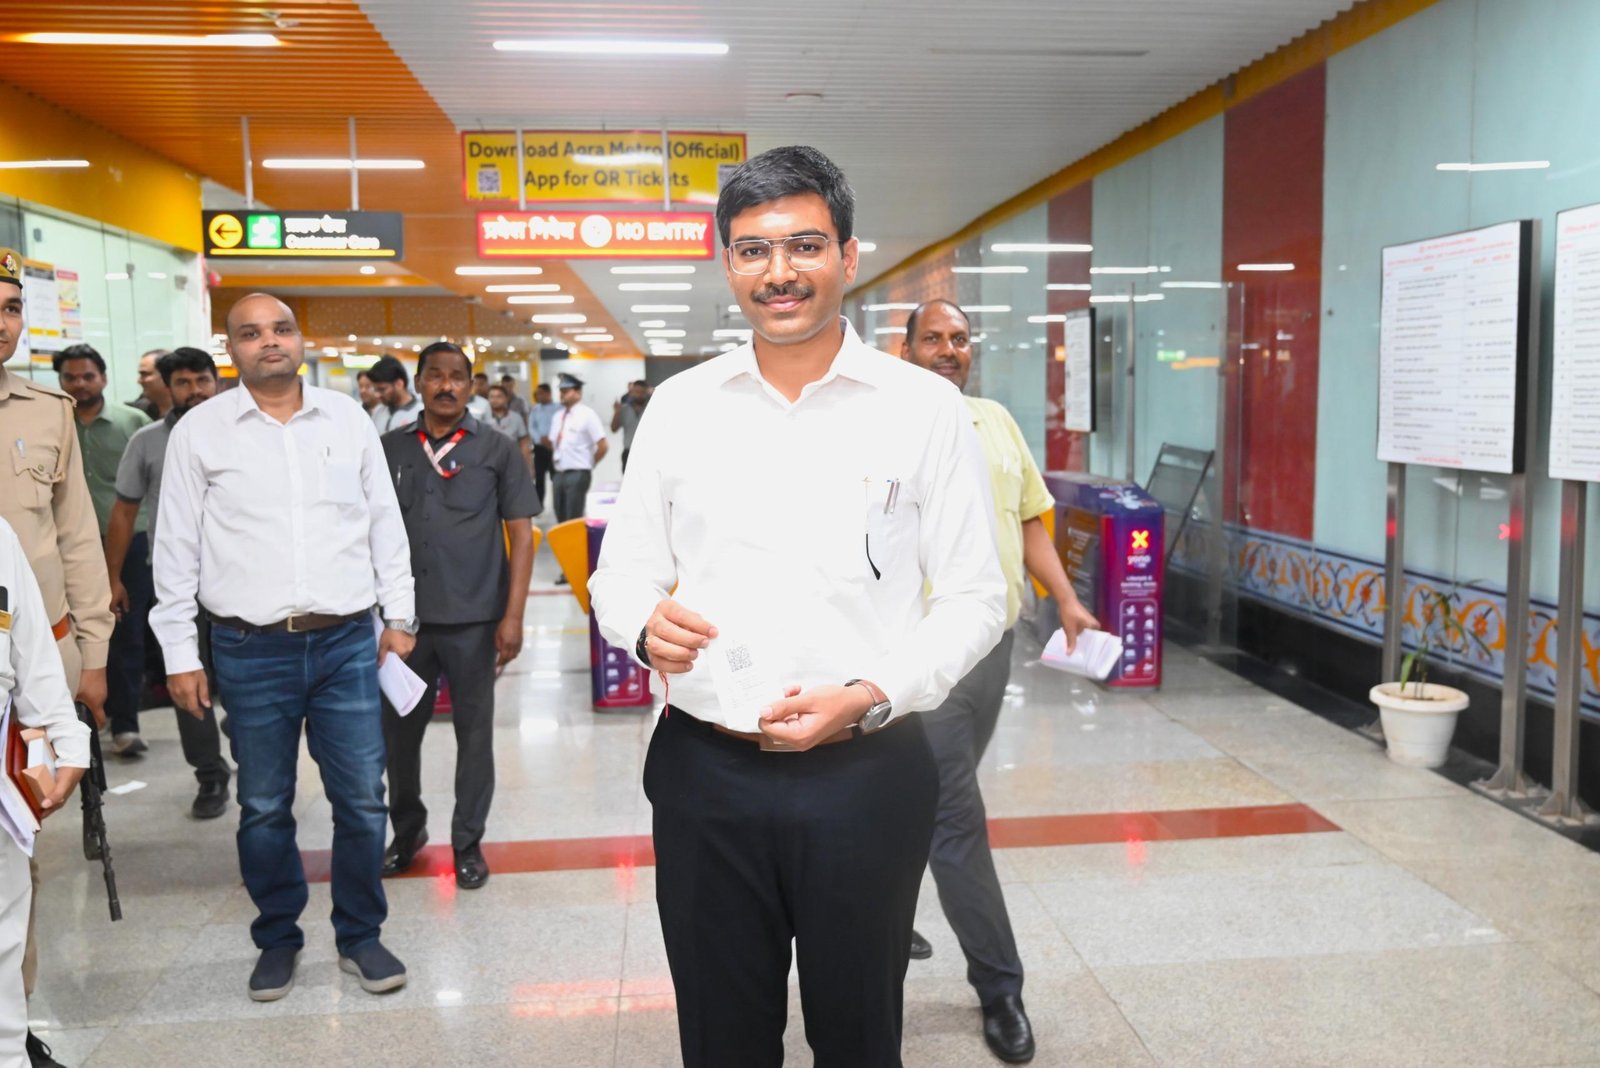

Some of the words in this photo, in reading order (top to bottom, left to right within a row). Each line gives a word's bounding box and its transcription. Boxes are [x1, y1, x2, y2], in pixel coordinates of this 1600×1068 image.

[667, 141, 740, 161] (Official)
[524, 170, 559, 190] App
[564, 170, 588, 186] for
[593, 170, 620, 187] QR
[616, 222, 644, 240] NO
[647, 222, 707, 240] ENTRY
